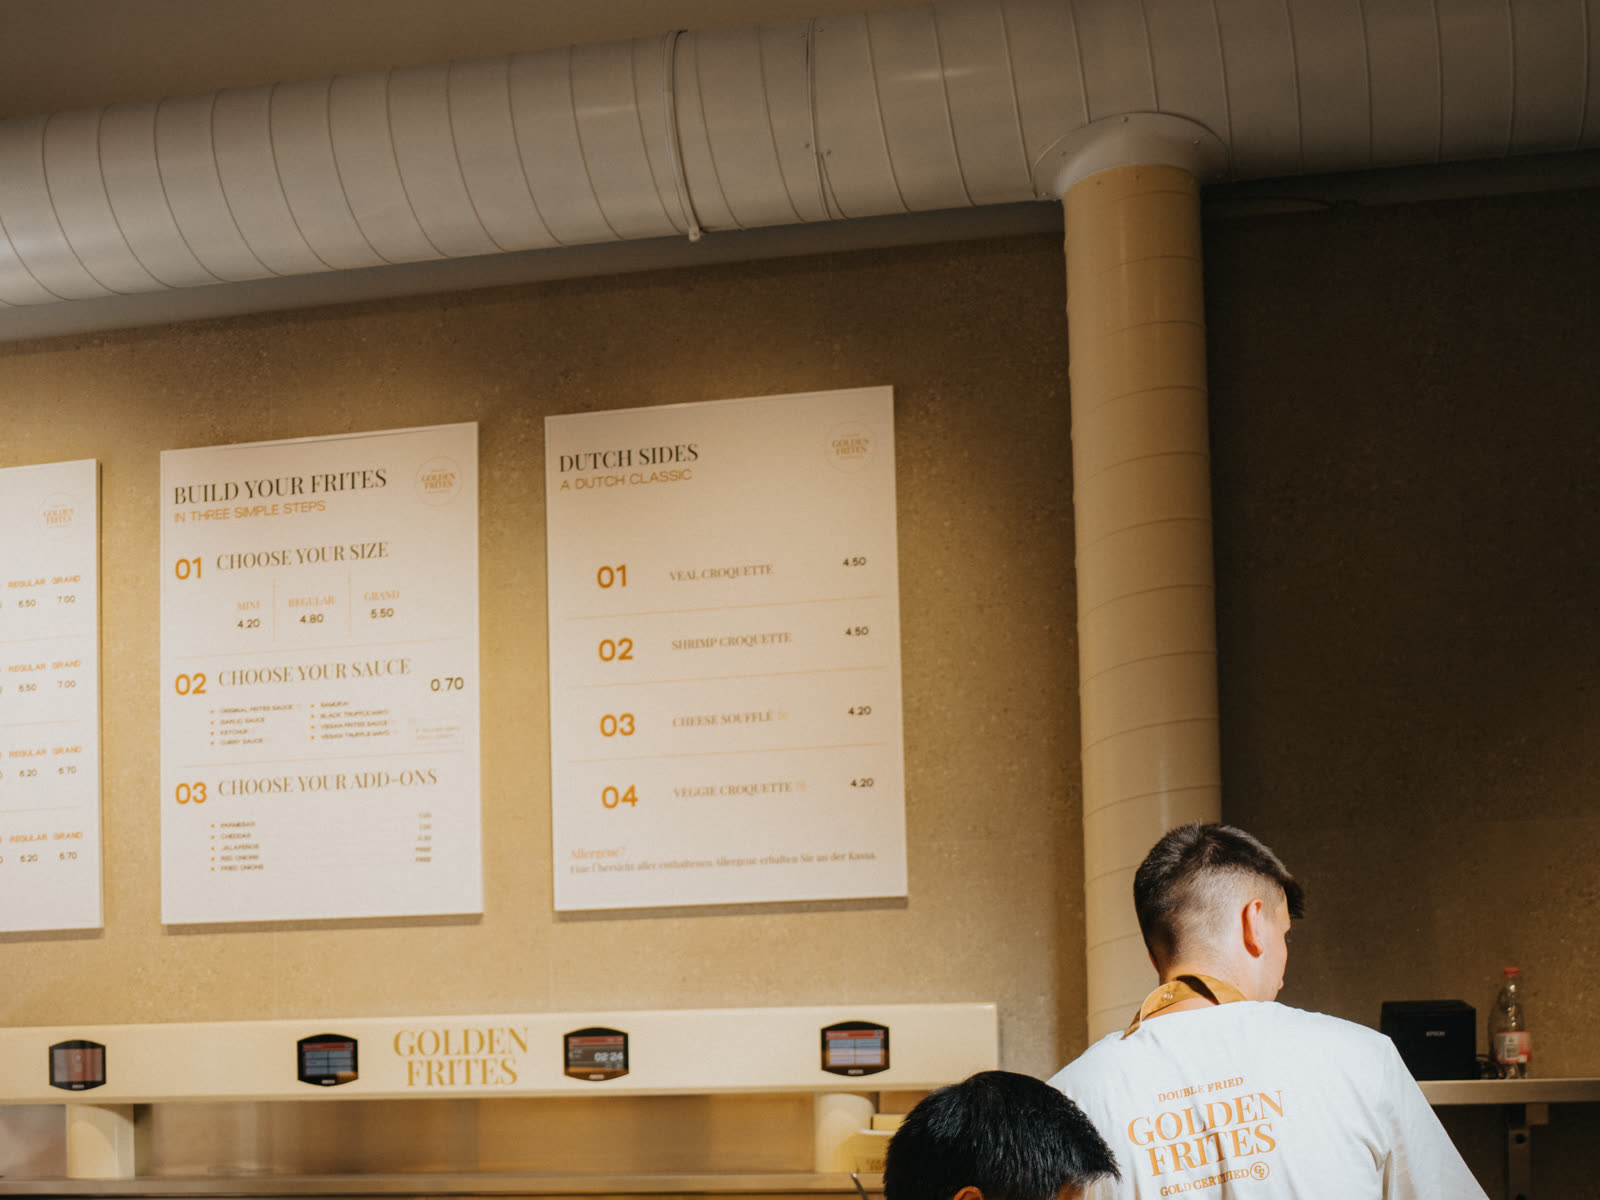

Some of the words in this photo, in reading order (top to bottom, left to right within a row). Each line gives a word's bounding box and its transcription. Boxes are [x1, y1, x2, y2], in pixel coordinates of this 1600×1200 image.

[560, 450, 632, 473] DUTCH
[639, 443, 699, 466] SIDES
[174, 483, 240, 505] BUILD
[245, 476, 304, 499] YOUR
[311, 468, 387, 494] FRITES
[560, 479, 571, 490] A
[575, 474, 625, 490] DUTCH
[629, 468, 693, 486] CLASSIC
[174, 511, 186, 522] IN
[189, 507, 231, 521] THREE
[234, 503, 281, 519] SIMPLE
[283, 499, 327, 515] STEPS
[174, 556, 203, 580] 01
[216, 550, 292, 570] CHOOSE
[295, 545, 345, 565] YOUR
[349, 541, 389, 560] SIZE
[842, 557, 867, 567] 4.50
[597, 564, 627, 589] 01
[669, 569, 699, 582] VEAL
[701, 563, 774, 581] CROQUETTE
[288, 595, 335, 608] REGULAR
[363, 589, 400, 602] GRAND
[237, 618, 261, 629] 4.20
[300, 613, 324, 624] 4.80
[370, 607, 394, 619] 5.50
[845, 626, 869, 637] 4.50
[598, 637, 634, 662] 02
[671, 637, 718, 651] SHRIMP
[719, 632, 792, 649] CROQUETTE
[175, 672, 207, 696] 02
[218, 665, 294, 687] CHOOSE
[298, 663, 347, 681] YOUR
[352, 658, 412, 678] SAUCE
[430, 676, 464, 692] 0.70
[848, 705, 872, 716] 4.20
[600, 712, 635, 737] 03
[672, 713, 719, 728] CHEESE
[175, 781, 207, 805] 03
[218, 776, 294, 797] CHOOSE
[298, 773, 346, 792] YOUR
[351, 768, 438, 790] ADD-ONS
[601, 783, 639, 809] 04
[673, 785, 718, 799] VEGGIE
[719, 781, 793, 798] CROQUETTE
[850, 777, 875, 788] 4.20
[393, 1027, 529, 1058] GOLDEN
[407, 1057, 518, 1087] FRITES
[1157, 1084, 1205, 1103] DOUBLE
[1207, 1076, 1245, 1093] FRIED
[1127, 1090, 1284, 1146] GOLDEN
[1146, 1122, 1276, 1177] FRITES
[1160, 1182, 1192, 1197] GOLD
[1193, 1167, 1250, 1190] CERTIFIED
